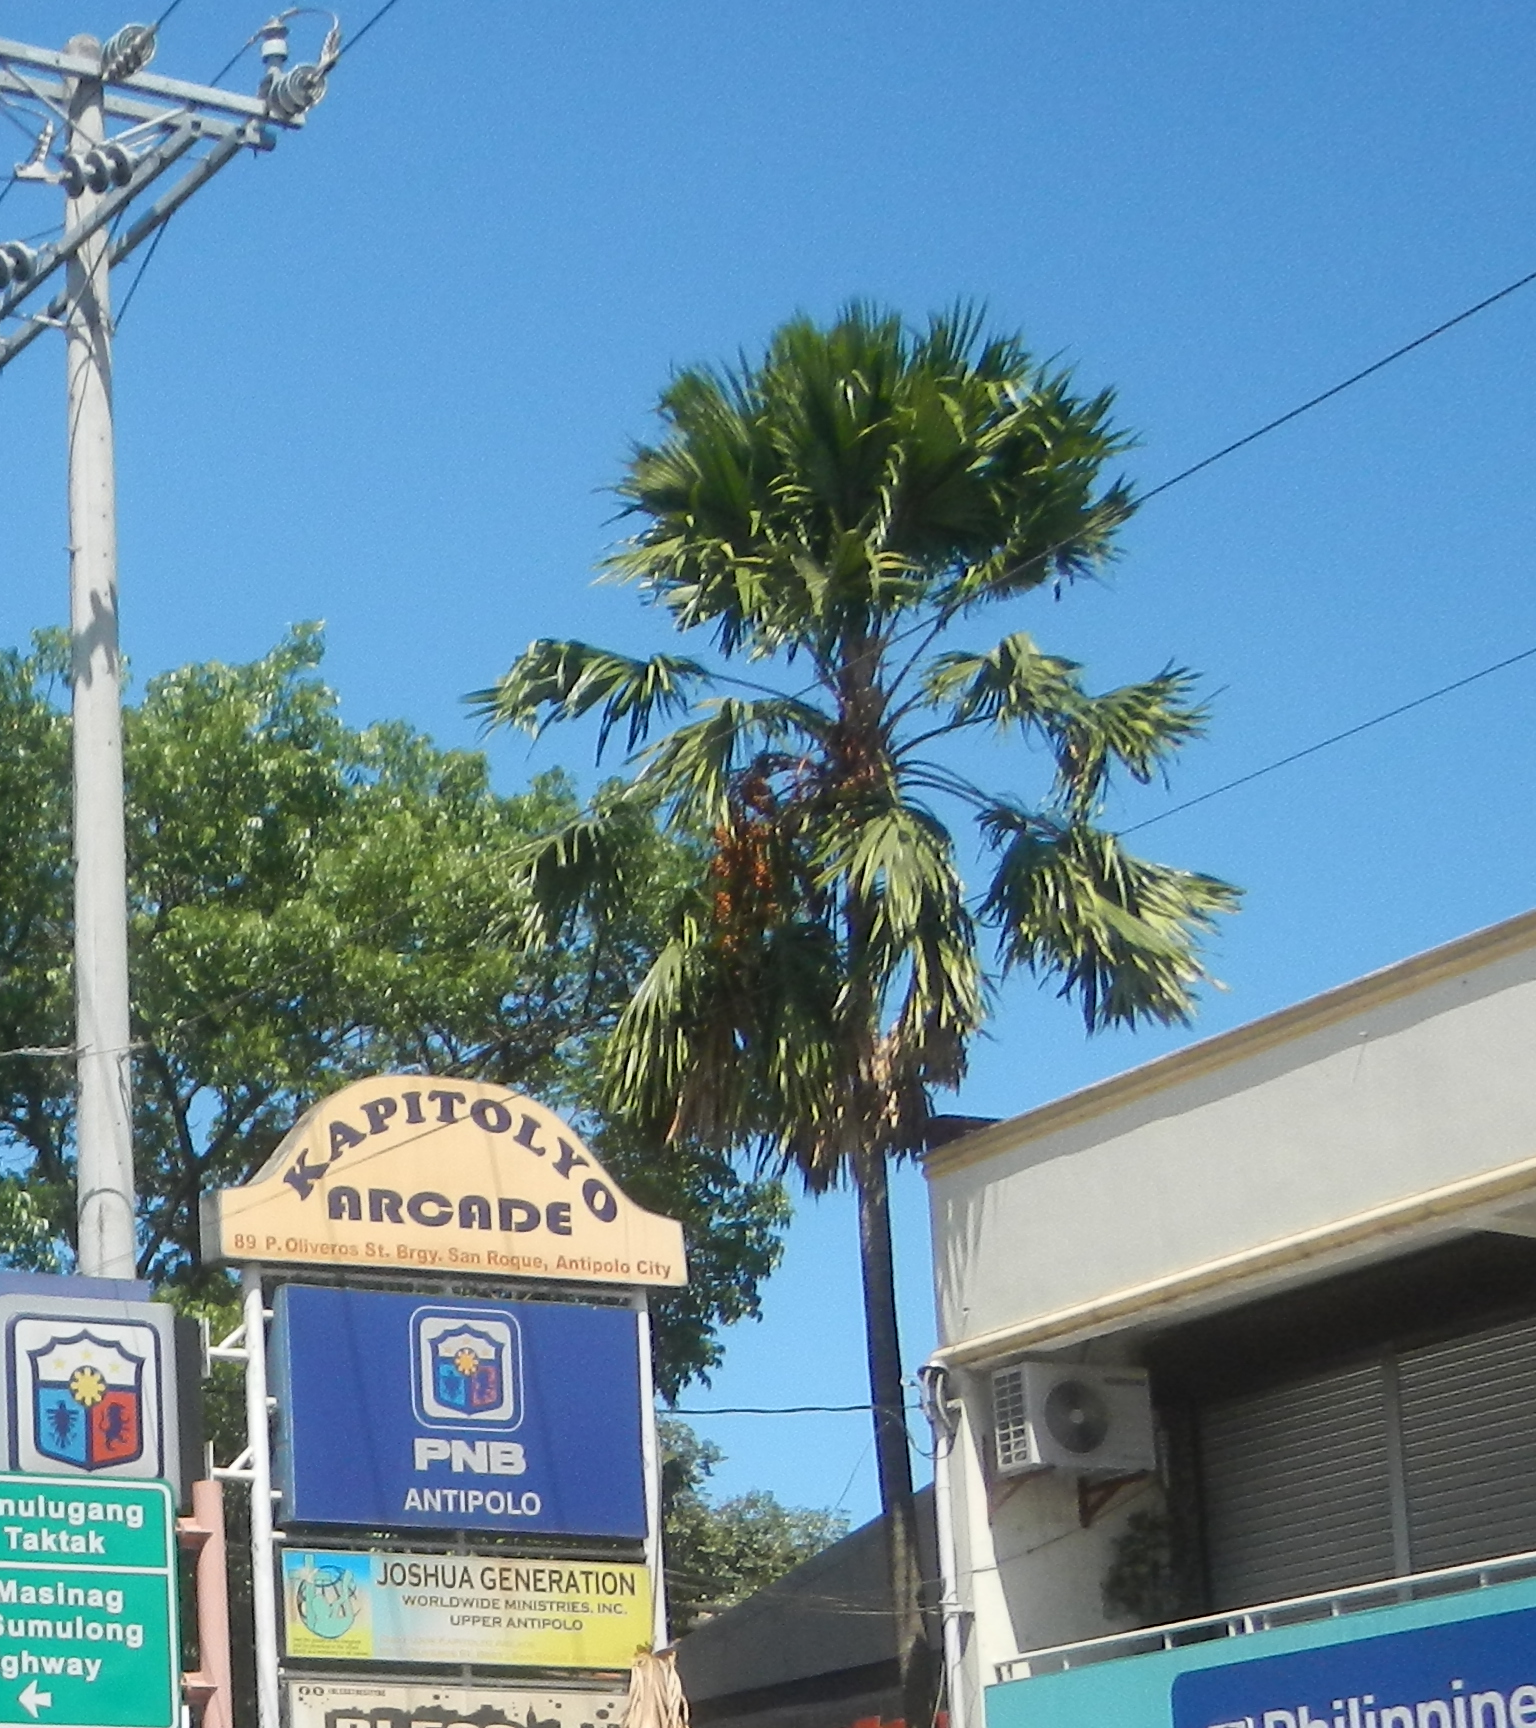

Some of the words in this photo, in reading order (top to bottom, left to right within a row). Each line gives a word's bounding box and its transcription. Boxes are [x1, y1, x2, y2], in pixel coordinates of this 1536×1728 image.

[283, 1090, 618, 1223] KAPITOLYO
[328, 1186, 573, 1236] ARCADE
[234, 1233, 256, 1250] 89
[285, 1237, 358, 1256] Oliveros
[365, 1242, 390, 1258] St.
[397, 1244, 442, 1264] Brgy.
[448, 1247, 480, 1263] San
[487, 1250, 548, 1271] Roque,
[556, 1255, 630, 1275] Antipolo
[637, 1260, 671, 1279] City
[413, 1437, 527, 1475] PNB
[404, 1488, 541, 1516] ANTIPOLO
[4, 1526, 106, 1555] Taktak
[377, 1562, 475, 1590] JOSHUA
[481, 1565, 636, 1597] GENERATION
[402, 1594, 503, 1611] WORLDWIDE
[597, 1602, 629, 1616] INC.
[450, 1614, 502, 1629] UPPER
[505, 1617, 584, 1632] ANTIPOLO
